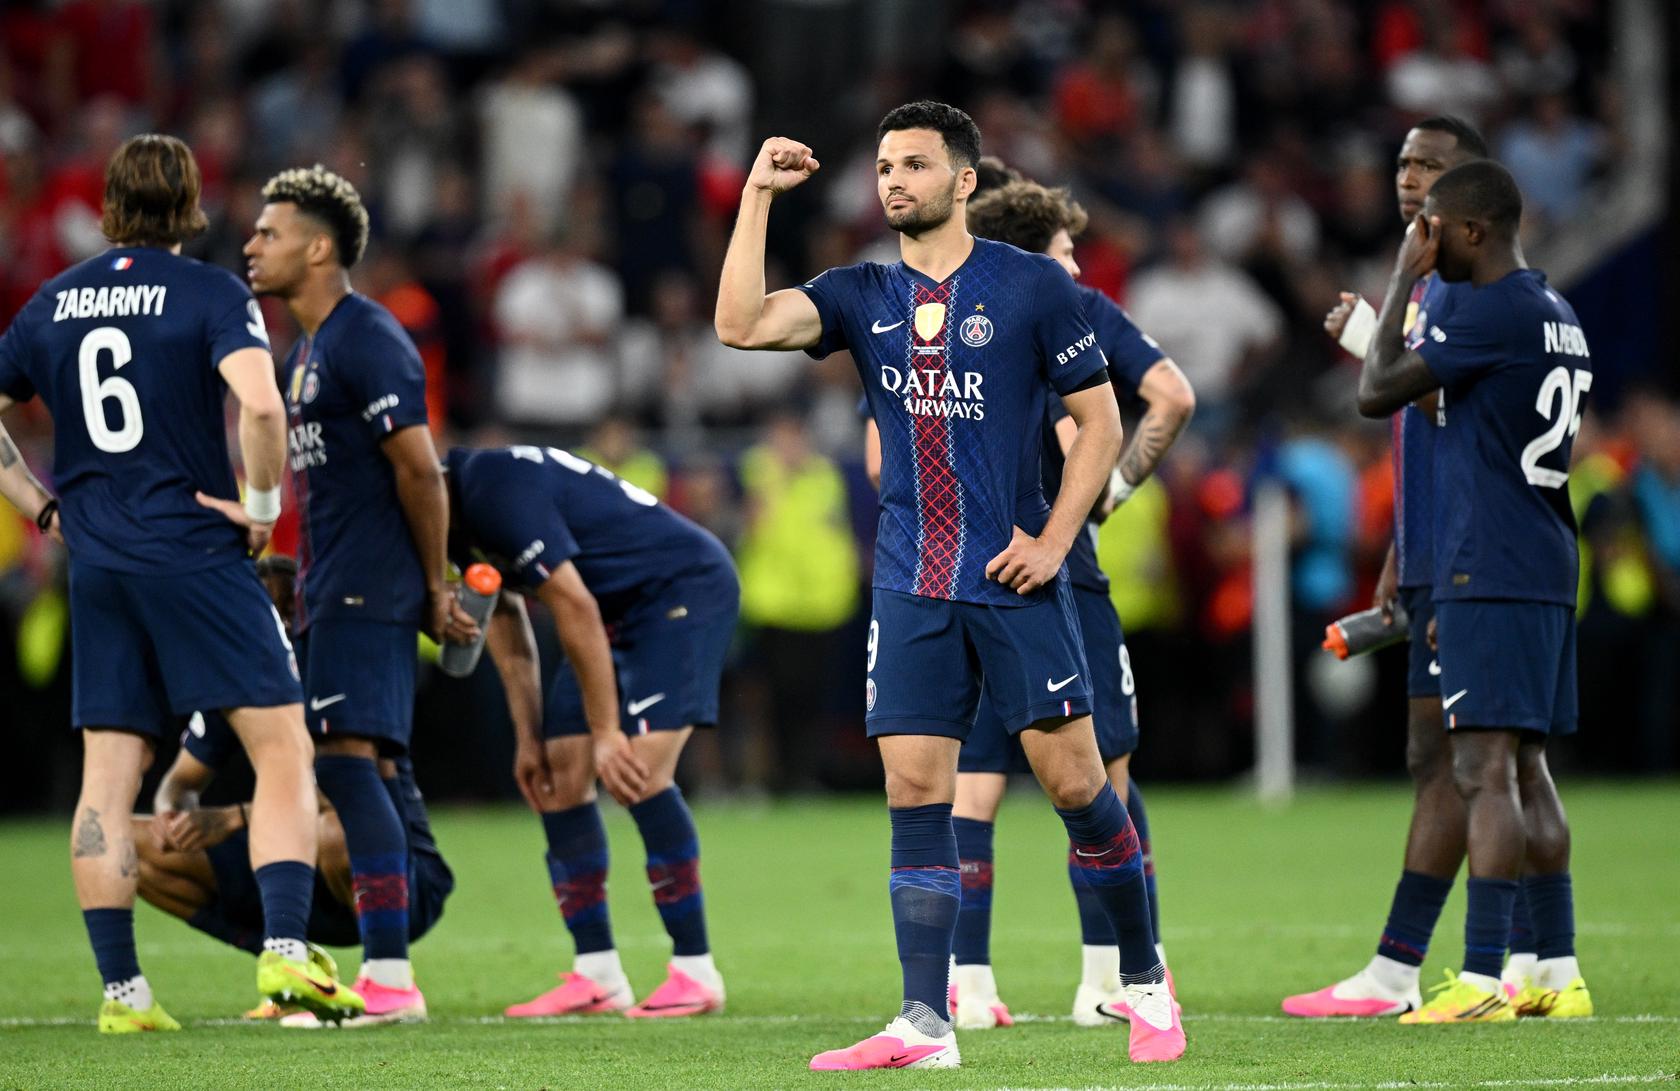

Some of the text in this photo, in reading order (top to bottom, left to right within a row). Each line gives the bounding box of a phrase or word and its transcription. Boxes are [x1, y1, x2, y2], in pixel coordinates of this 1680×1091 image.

[53, 285, 167, 322] ZABARNYI
[78, 326, 144, 453] 6
[881, 365, 985, 400] QATAR
[903, 397, 985, 421] AIRWAYS
[867, 620, 880, 673] 9
[1118, 643, 1135, 696] 8
